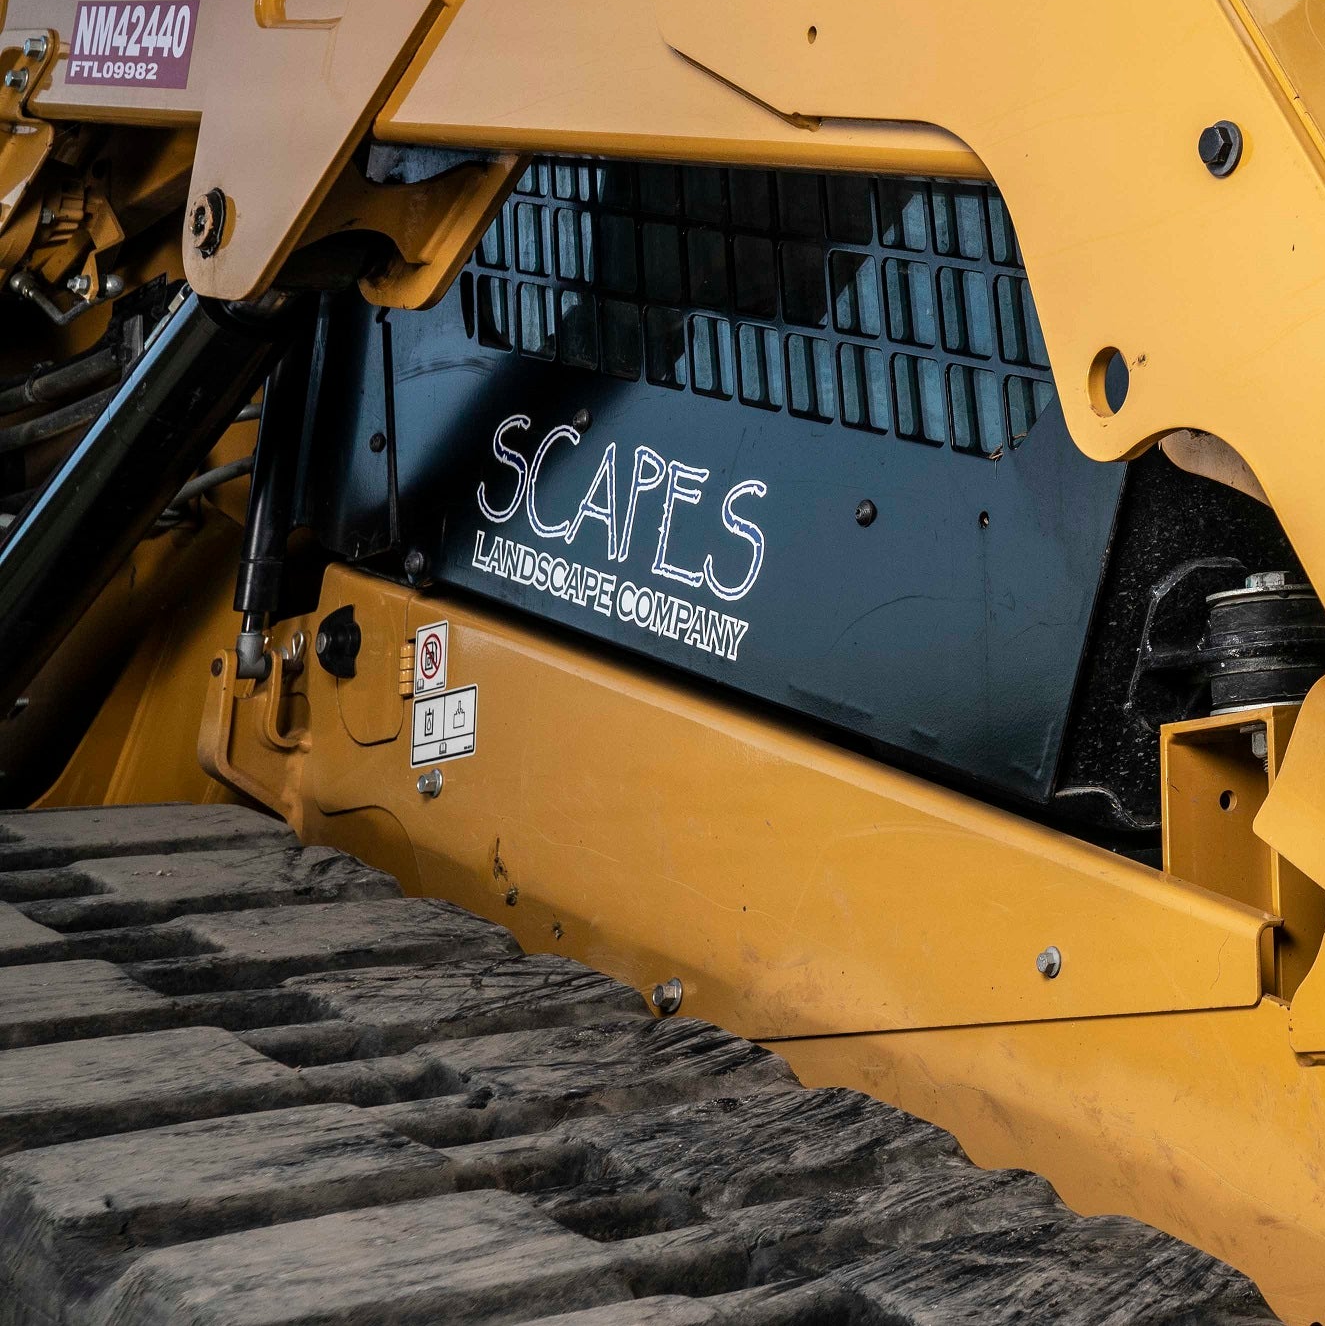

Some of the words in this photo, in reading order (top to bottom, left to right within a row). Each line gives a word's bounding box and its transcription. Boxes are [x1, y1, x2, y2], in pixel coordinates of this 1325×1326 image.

[70, 60, 158, 80] FTL09982
[74, 4, 191, 59] NM42440
[477, 414, 767, 601] SCAPES
[472, 529, 617, 617] LANDSCAPE
[616, 581, 749, 662] COMPANY
